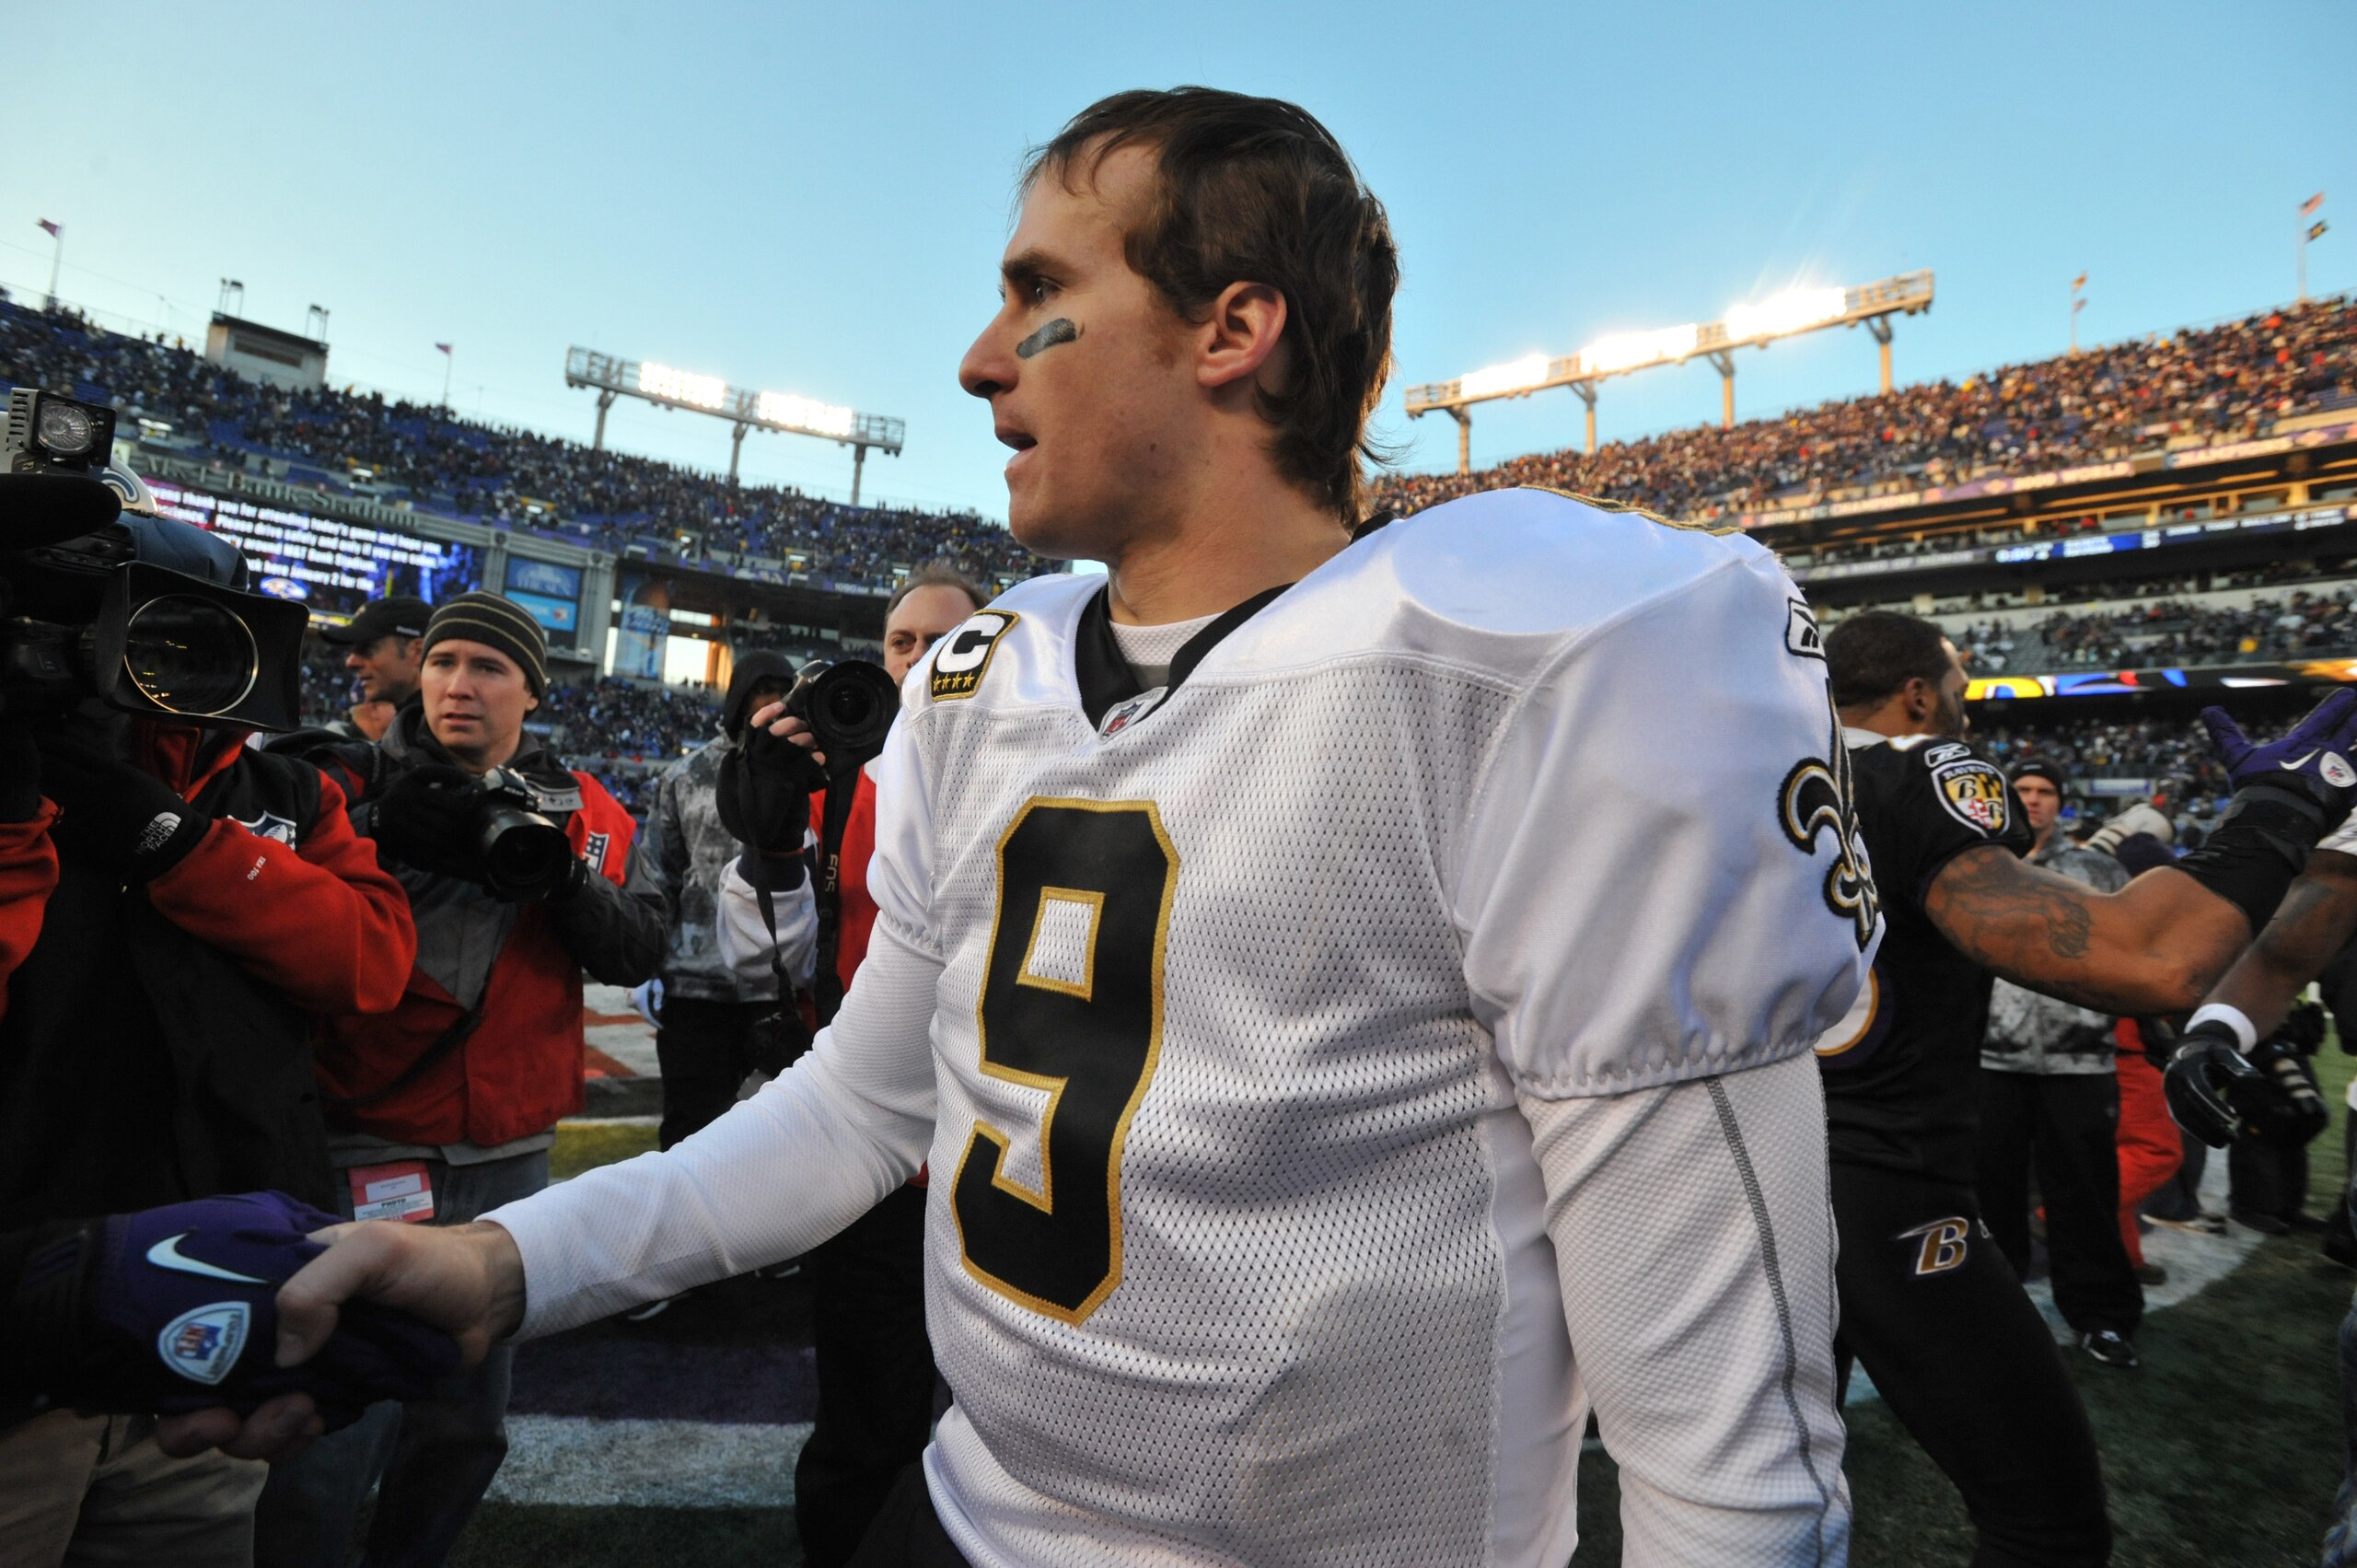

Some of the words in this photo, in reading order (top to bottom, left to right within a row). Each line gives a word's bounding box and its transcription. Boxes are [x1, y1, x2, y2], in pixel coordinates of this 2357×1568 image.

[217, 500, 239, 516] you
[226, 471, 300, 504] Bank
[311, 491, 418, 528] Stadium
[215, 513, 254, 534] Please
[936, 614, 1005, 673] C
[134, 824, 168, 854] NORTH
[140, 820, 161, 839] THE
[149, 828, 174, 852] FACE
[950, 796, 1181, 1329] 9
